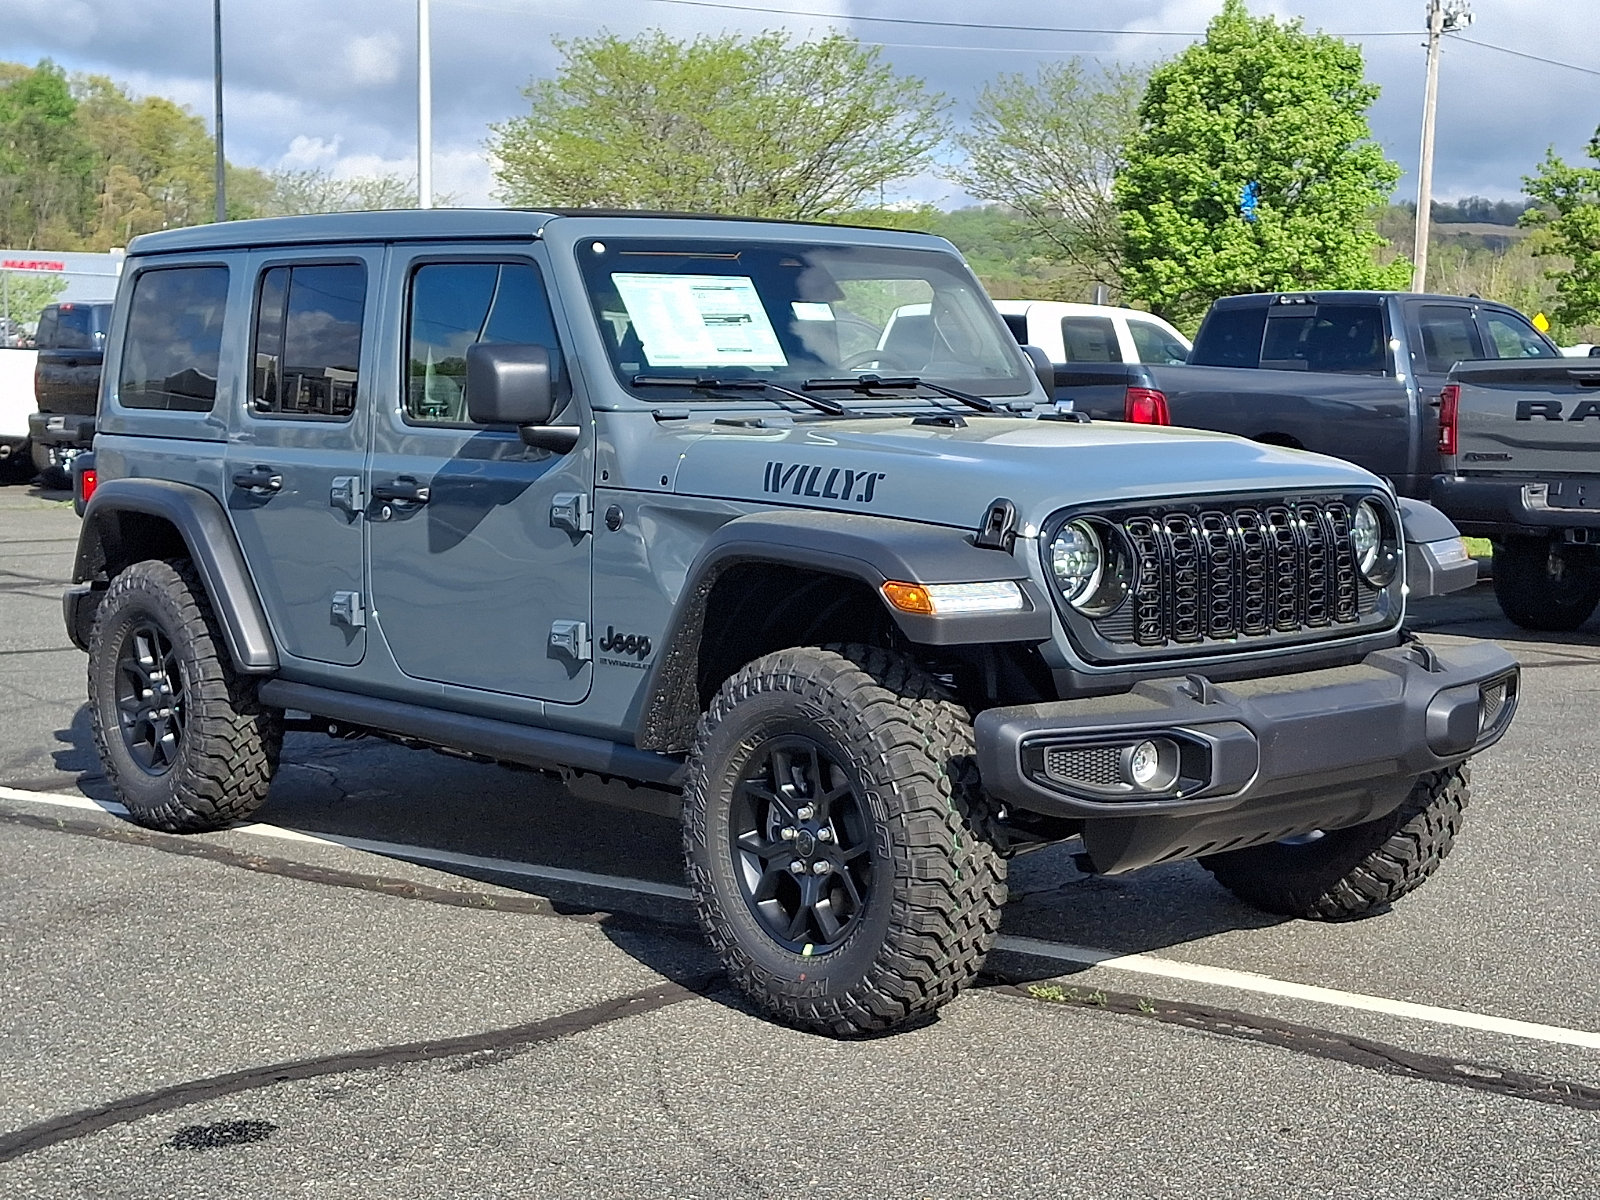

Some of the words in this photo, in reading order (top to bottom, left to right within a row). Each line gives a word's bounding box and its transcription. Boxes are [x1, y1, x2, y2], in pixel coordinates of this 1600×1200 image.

[3, 260, 64, 270] MARTIN
[763, 461, 886, 503] WILLYS
[599, 625, 652, 661] Jeep
